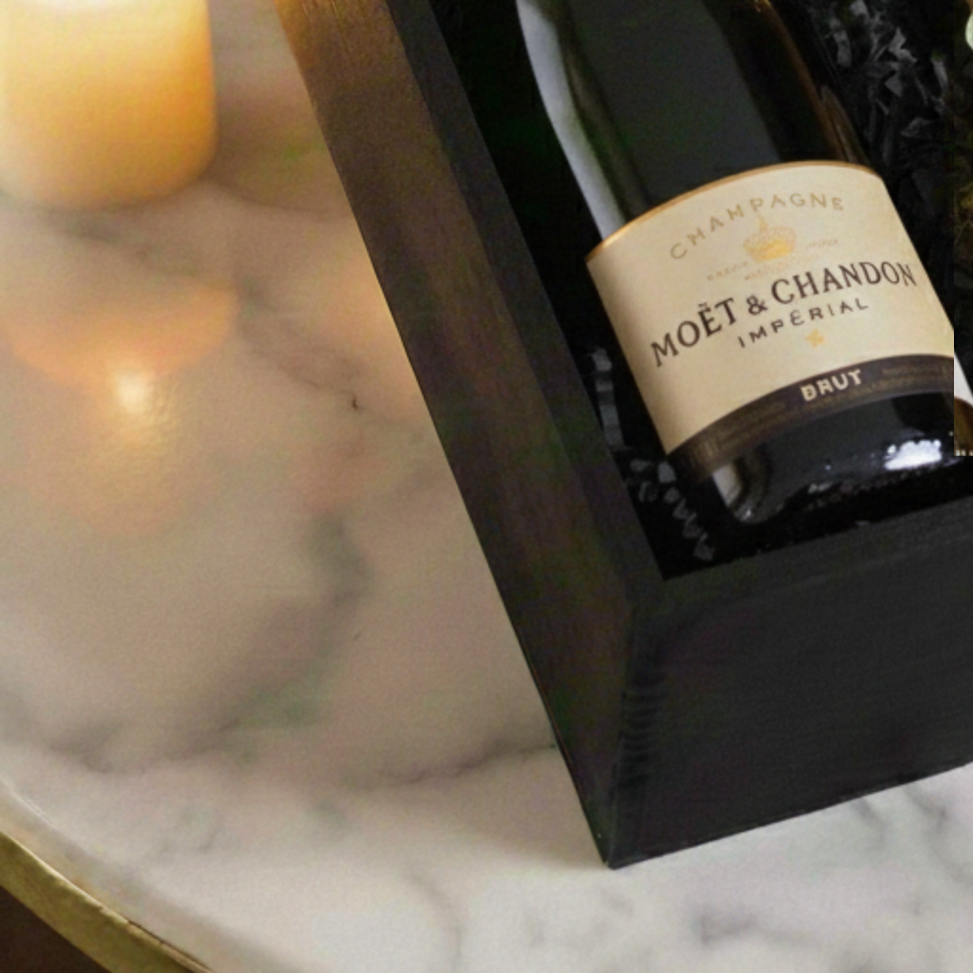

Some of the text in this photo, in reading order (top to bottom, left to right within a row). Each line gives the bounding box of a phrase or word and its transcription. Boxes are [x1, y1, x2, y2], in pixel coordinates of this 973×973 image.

[670, 192, 844, 260] CHAMPAGNE
[746, 295, 768, 316] &
[771, 261, 917, 305] CHANDON
[801, 369, 862, 402] BRUT
